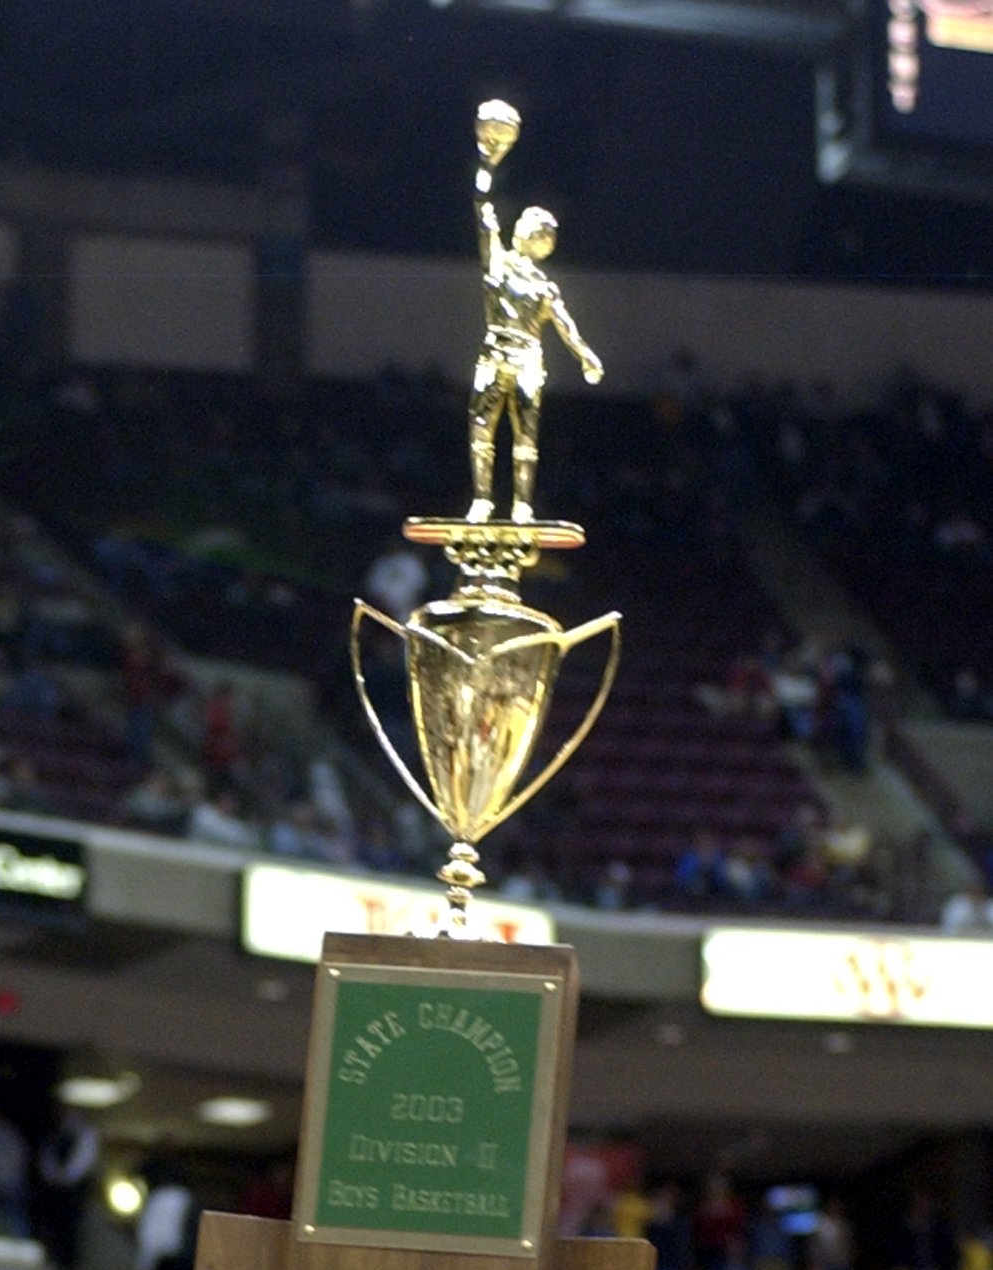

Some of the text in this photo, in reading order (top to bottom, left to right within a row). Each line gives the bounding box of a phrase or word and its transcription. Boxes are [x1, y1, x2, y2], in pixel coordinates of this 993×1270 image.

[337, 1002, 524, 1094] STATE CHAMPION
[390, 1092, 465, 1124] 2003
[348, 1133, 459, 1168] DIVISION
[328, 1179, 510, 1218] BOYS BASKETBALL
